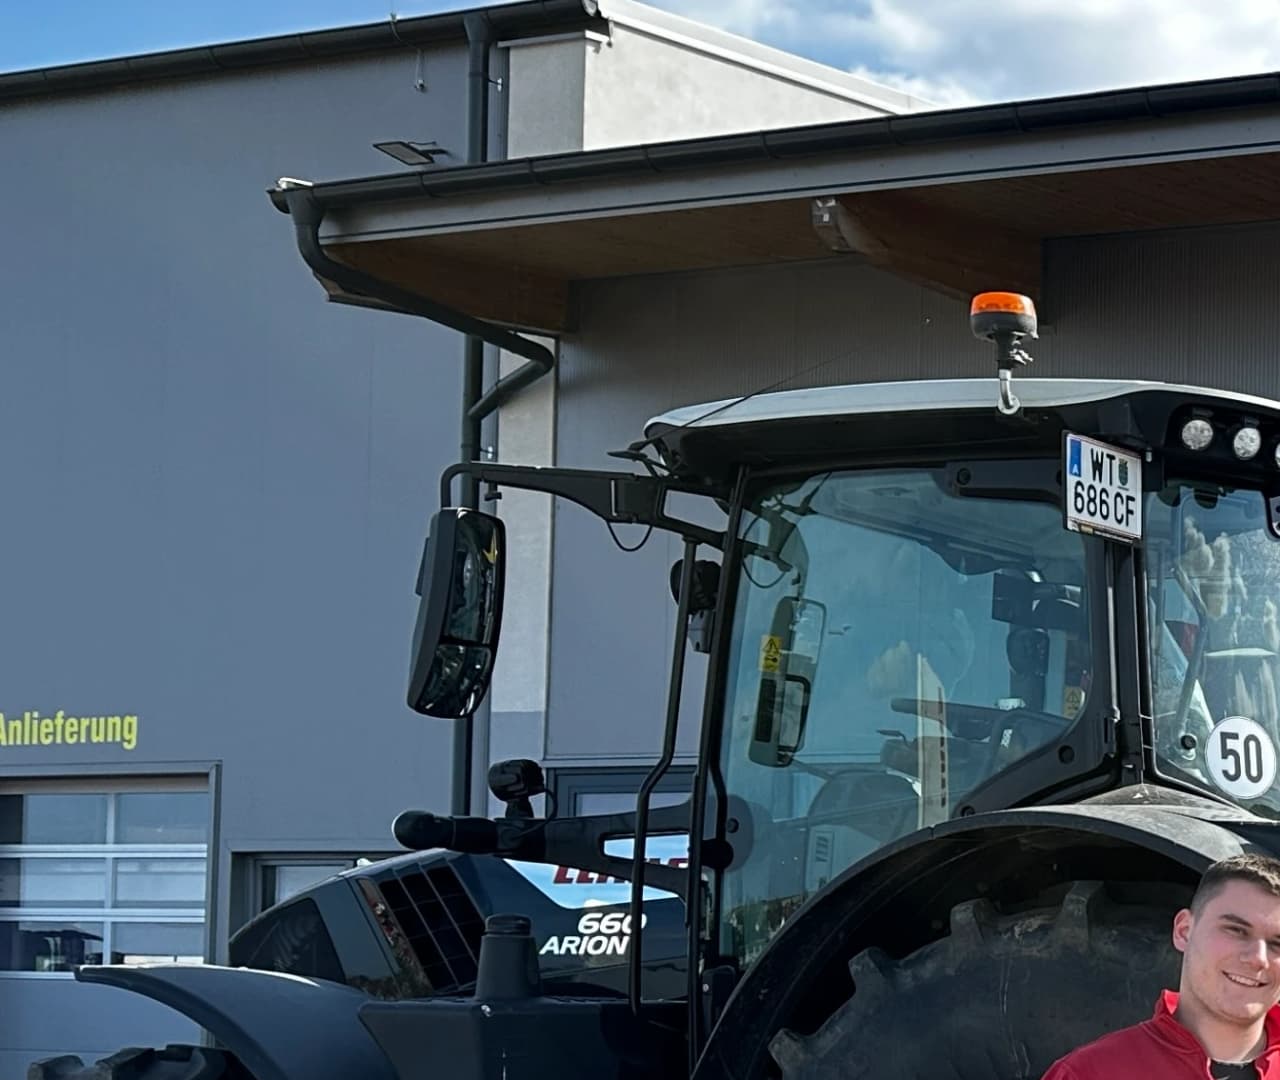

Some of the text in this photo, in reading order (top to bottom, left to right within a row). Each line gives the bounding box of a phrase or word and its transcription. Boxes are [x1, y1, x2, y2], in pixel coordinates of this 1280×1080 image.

[1090, 448, 1116, 486] WT
[0, 710, 138, 750] Anlieferung
[1220, 731, 1264, 783] 50
[539, 936, 631, 955] ARION
